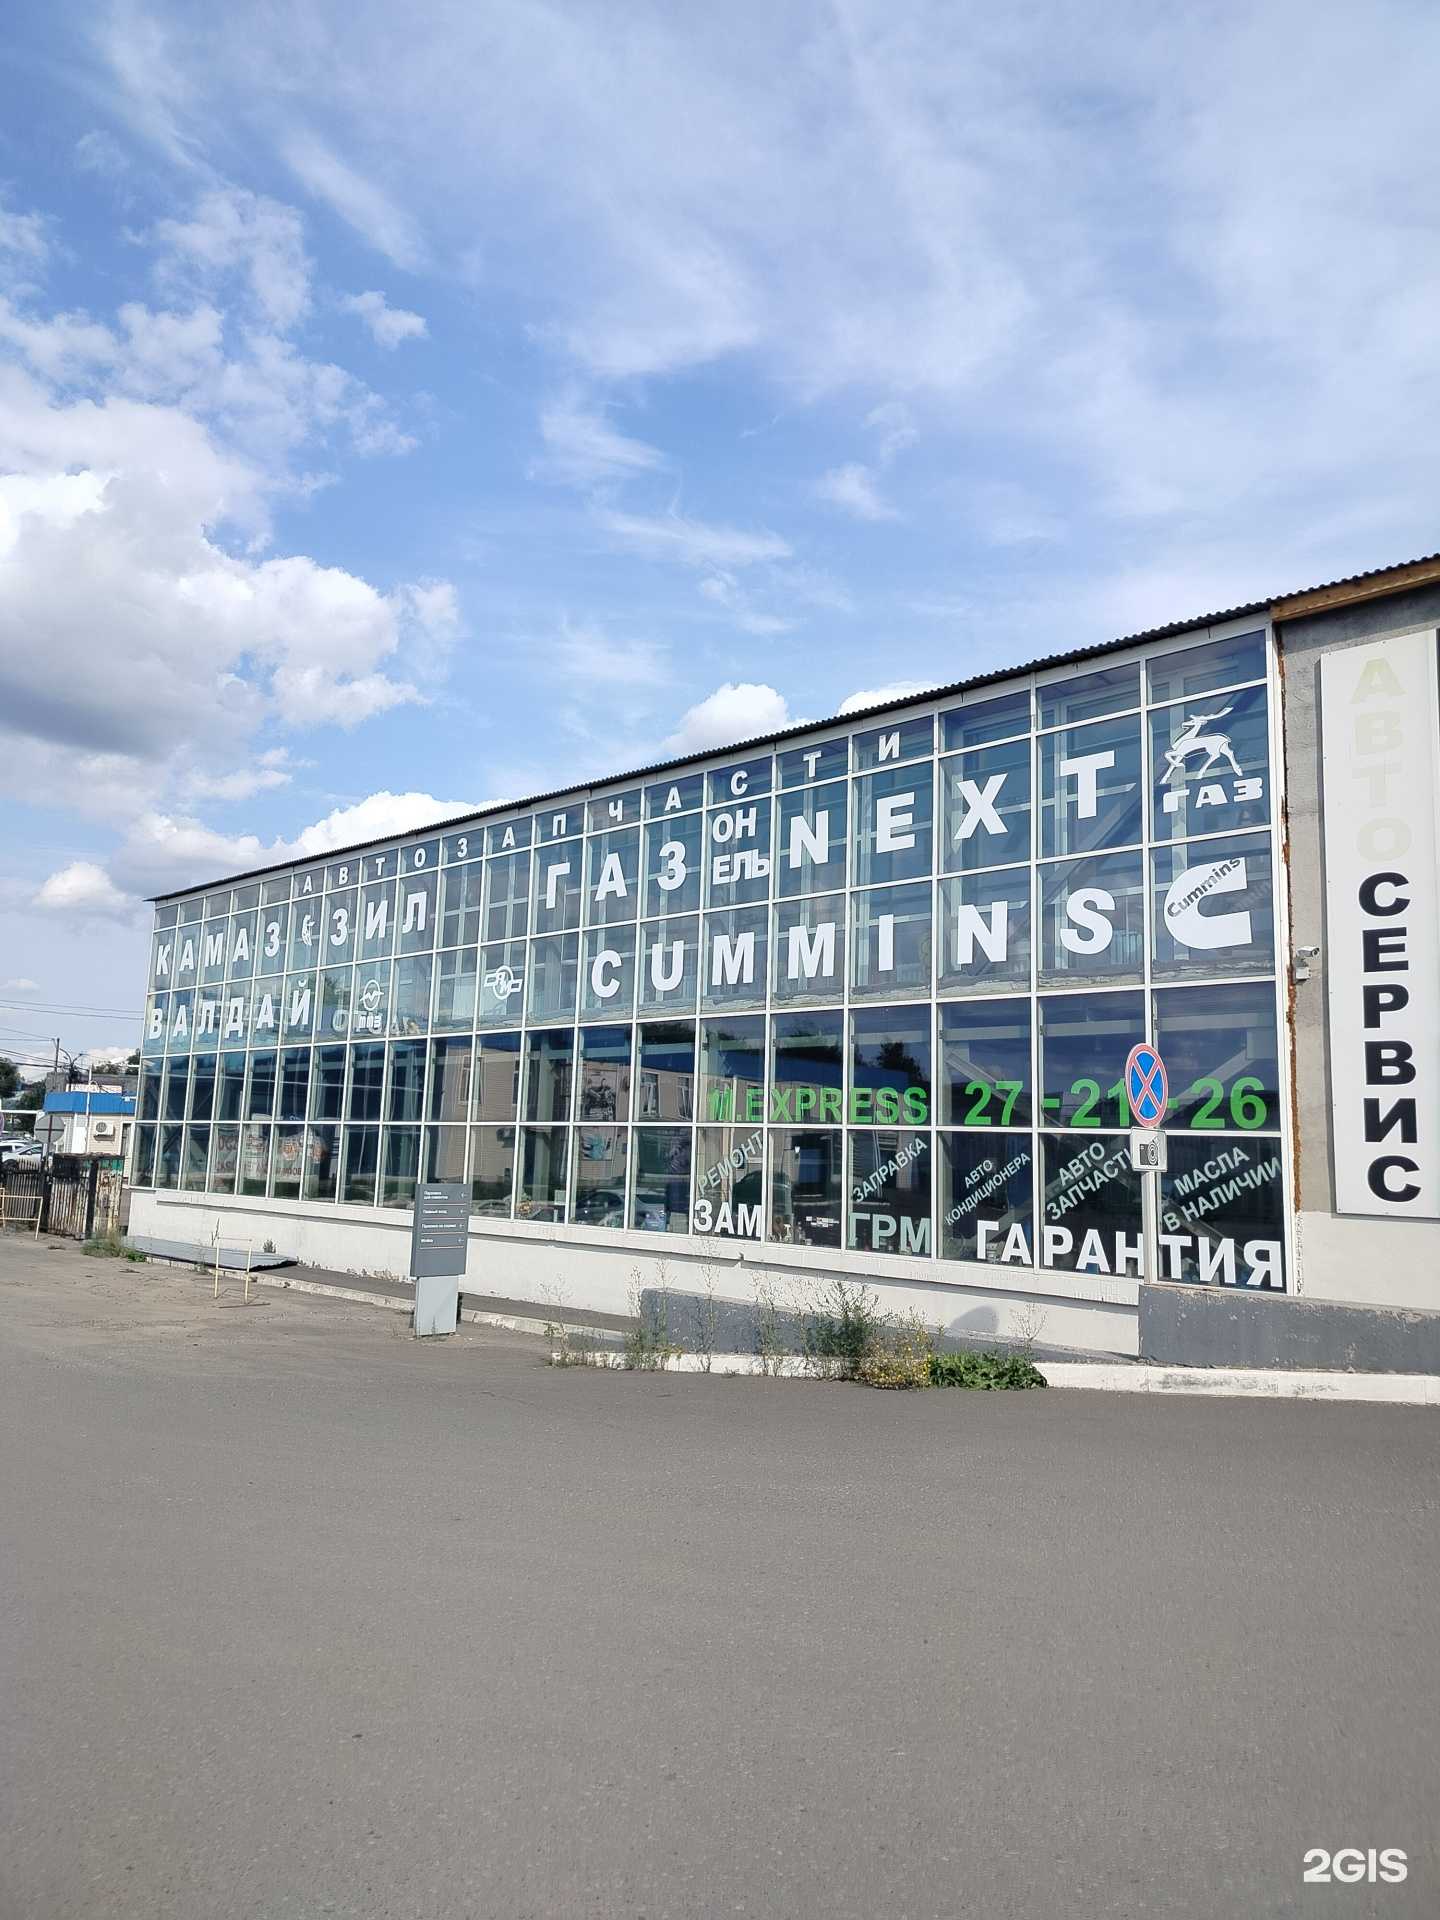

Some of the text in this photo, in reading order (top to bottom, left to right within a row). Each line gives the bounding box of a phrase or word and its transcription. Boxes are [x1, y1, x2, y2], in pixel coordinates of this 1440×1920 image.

[1163, 777, 1263, 813] ГАЗ
[546, 840, 687, 909] ГАЗ
[789, 750, 1115, 869] NEXT
[1167, 856, 1241, 918] Cummins
[156, 892, 427, 976] КАМАЗ ЗИЛ
[591, 888, 1116, 998] CUMMINS
[149, 979, 311, 1040] ВАЛДАЙ
[1358, 871, 1422, 1203] СЕРВИС
[698, 1130, 763, 1197] РЕМОНТ
[853, 1137, 928, 1204] ЗАПРАВКА
[944, 1152, 1031, 1226] КОНДИЦИОНЕРА
[964, 1159, 993, 1189] АВТО
[1058, 1142, 1105, 1186] АВТО
[1162, 1157, 1282, 1232] В НАЛИЧИИ
[1174, 1146, 1250, 1197] МАСЛА
[694, 1199, 763, 1238] ЗАМ
[848, 1212, 931, 1254] ГРМ
[977, 1219, 1283, 1288] ГАРАНТИЯ
